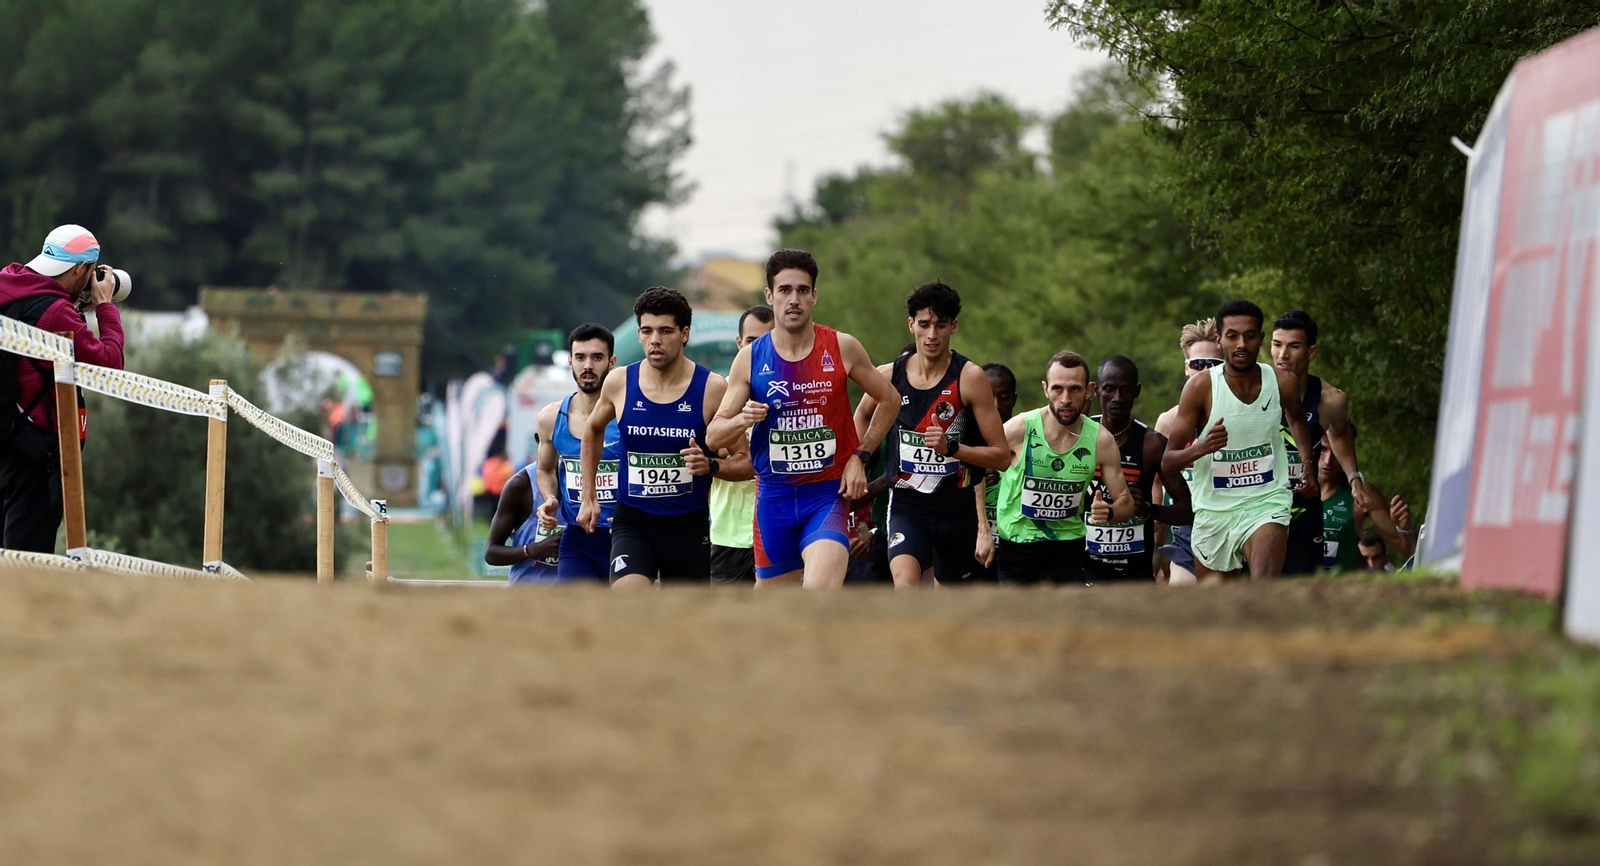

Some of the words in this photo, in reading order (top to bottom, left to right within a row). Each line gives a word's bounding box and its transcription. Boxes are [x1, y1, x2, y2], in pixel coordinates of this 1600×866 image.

[792, 380, 832, 393] lapalma
[777, 414, 824, 430] DELSUR
[627, 425, 696, 438] TROTASIERRA
[782, 431, 821, 442] ITÁLICA
[780, 443, 826, 460] 1318
[1226, 448, 1262, 460] ITÁLICA
[640, 455, 678, 466] ITÁLICA
[786, 460, 823, 472] Joma
[913, 463, 947, 473] Joma
[1229, 460, 1259, 475] AYELE
[638, 469, 681, 484] 1942
[1226, 474, 1264, 488] Joma
[642, 484, 678, 495] Joma
[1038, 481, 1074, 492] ITÁLICA
[1031, 493, 1074, 508] 2065
[1033, 508, 1067, 518] Joma
[1095, 528, 1135, 542] 2179
[1098, 543, 1132, 553] Joma
